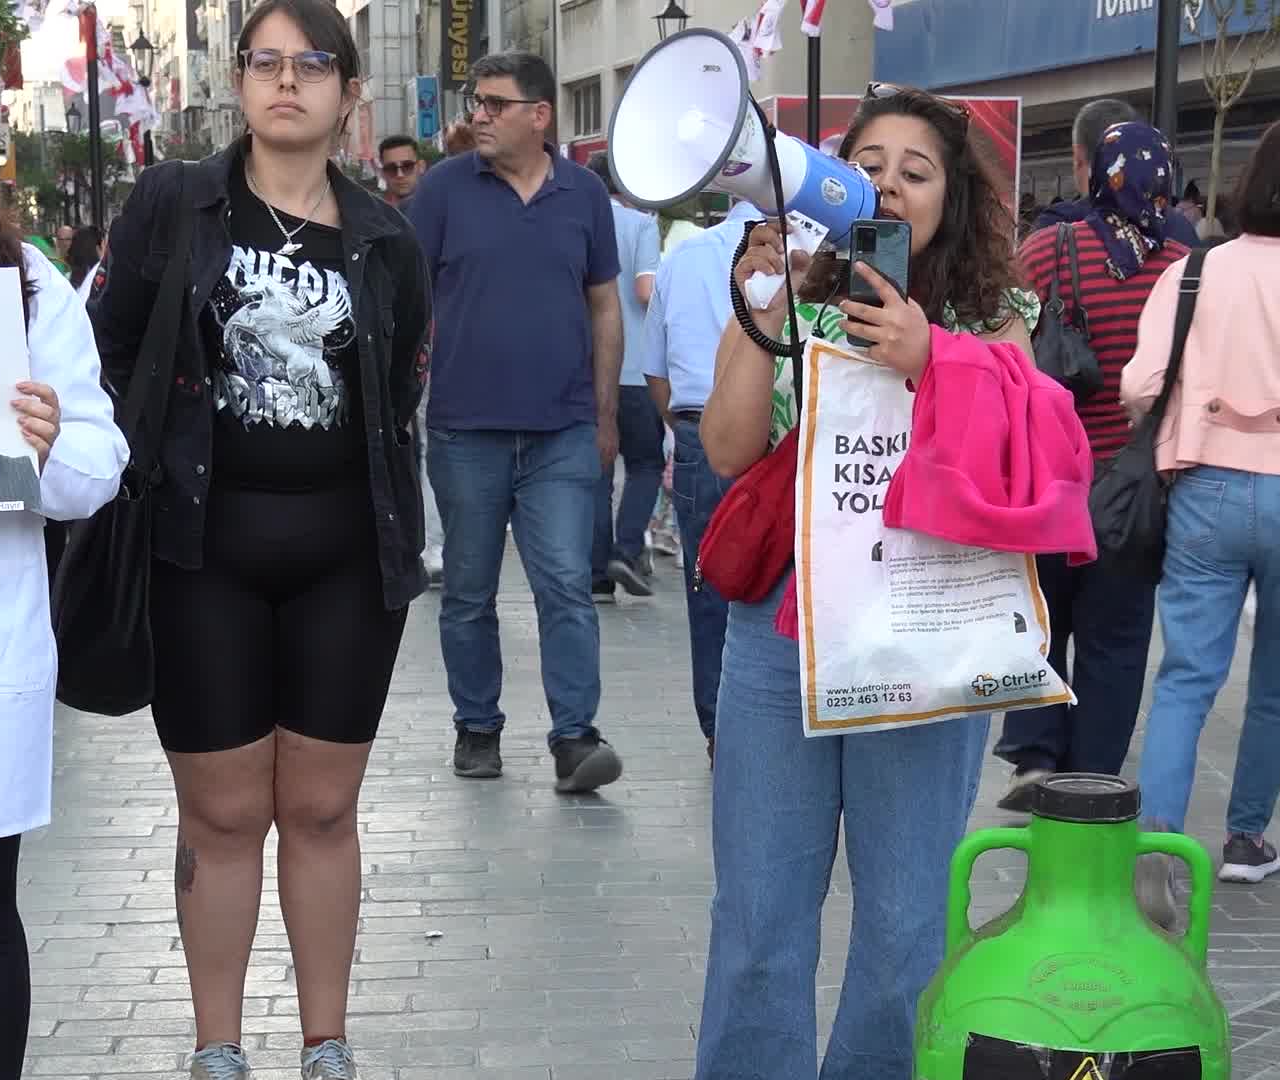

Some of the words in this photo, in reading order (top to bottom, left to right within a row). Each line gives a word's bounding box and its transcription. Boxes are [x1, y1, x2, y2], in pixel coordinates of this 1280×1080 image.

[1002, 668, 1048, 687] Ctrl+P
[826, 696, 854, 708] 0232
[858, 695, 879, 705] 463
[882, 693, 896, 704] 12
[899, 692, 912, 702] 63
